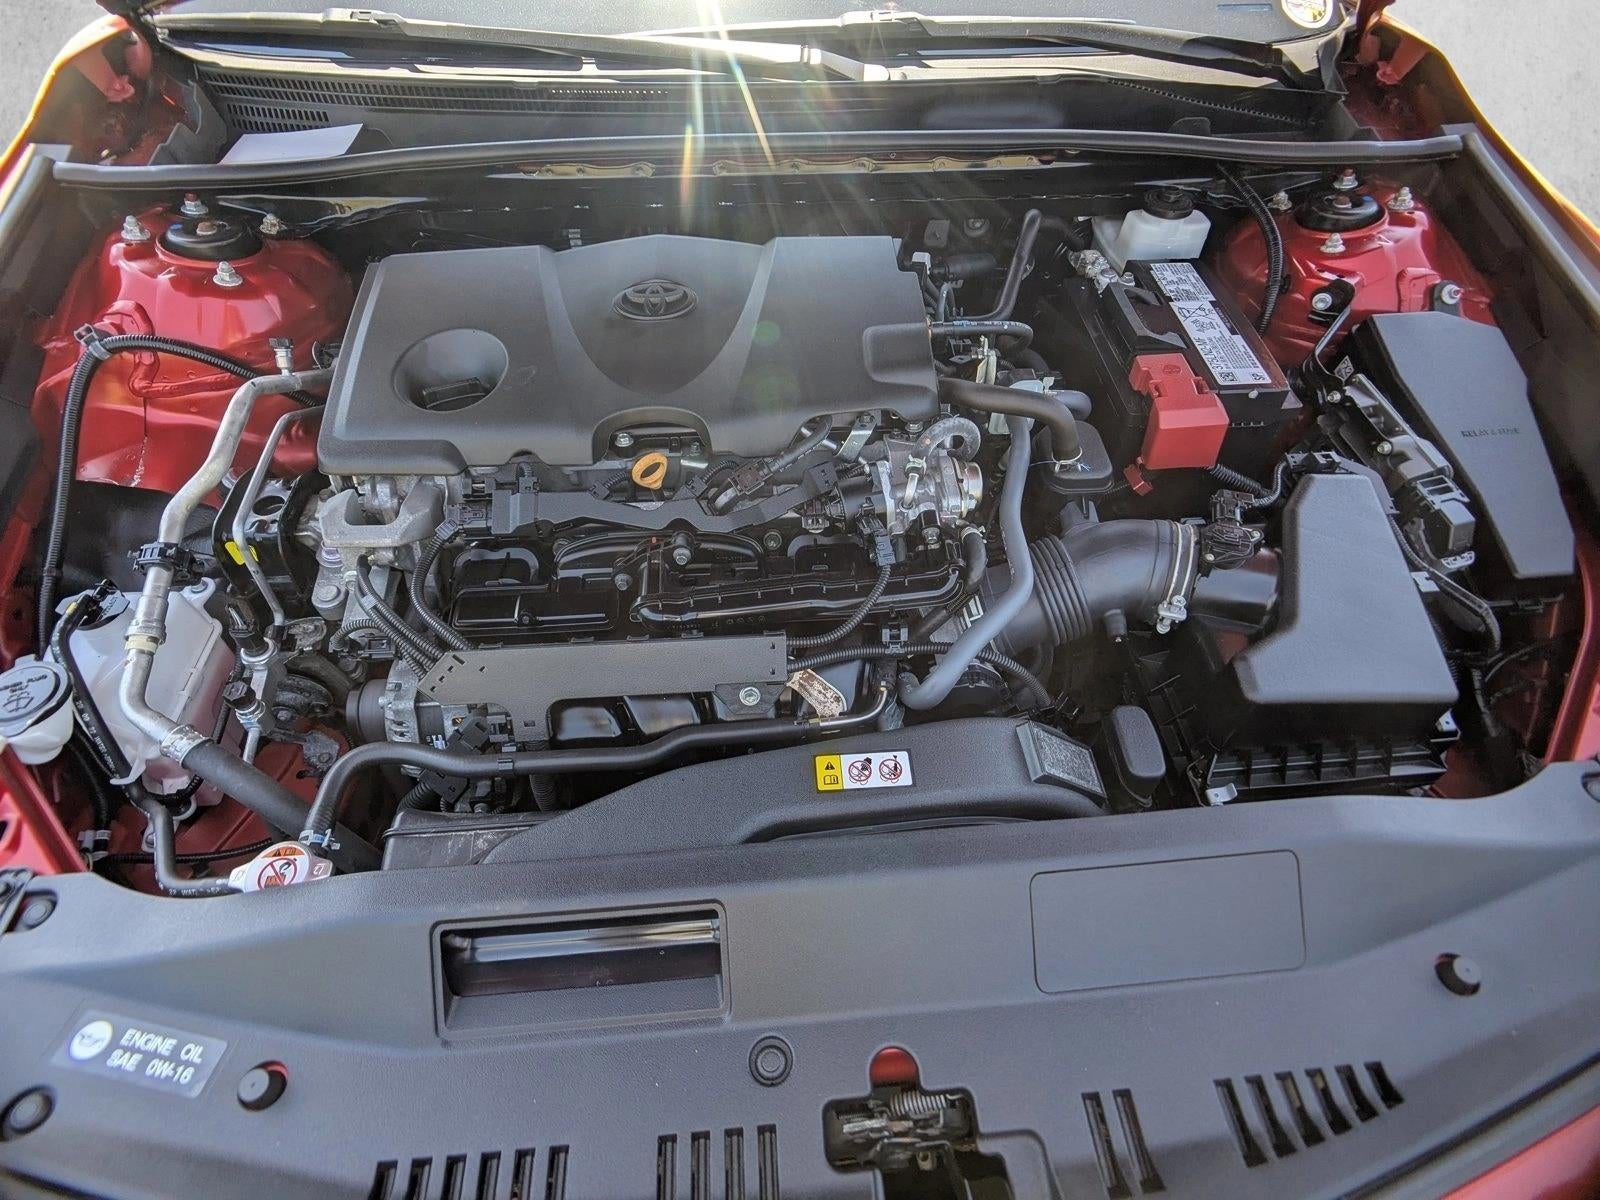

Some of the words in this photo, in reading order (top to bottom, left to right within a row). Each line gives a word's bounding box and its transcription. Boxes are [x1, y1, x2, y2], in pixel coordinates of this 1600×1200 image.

[120, 1028, 178, 1056] ENGINE
[180, 1043, 205, 1064] OIL
[106, 1049, 143, 1072] SAE
[145, 1058, 195, 1084] 0W-16
